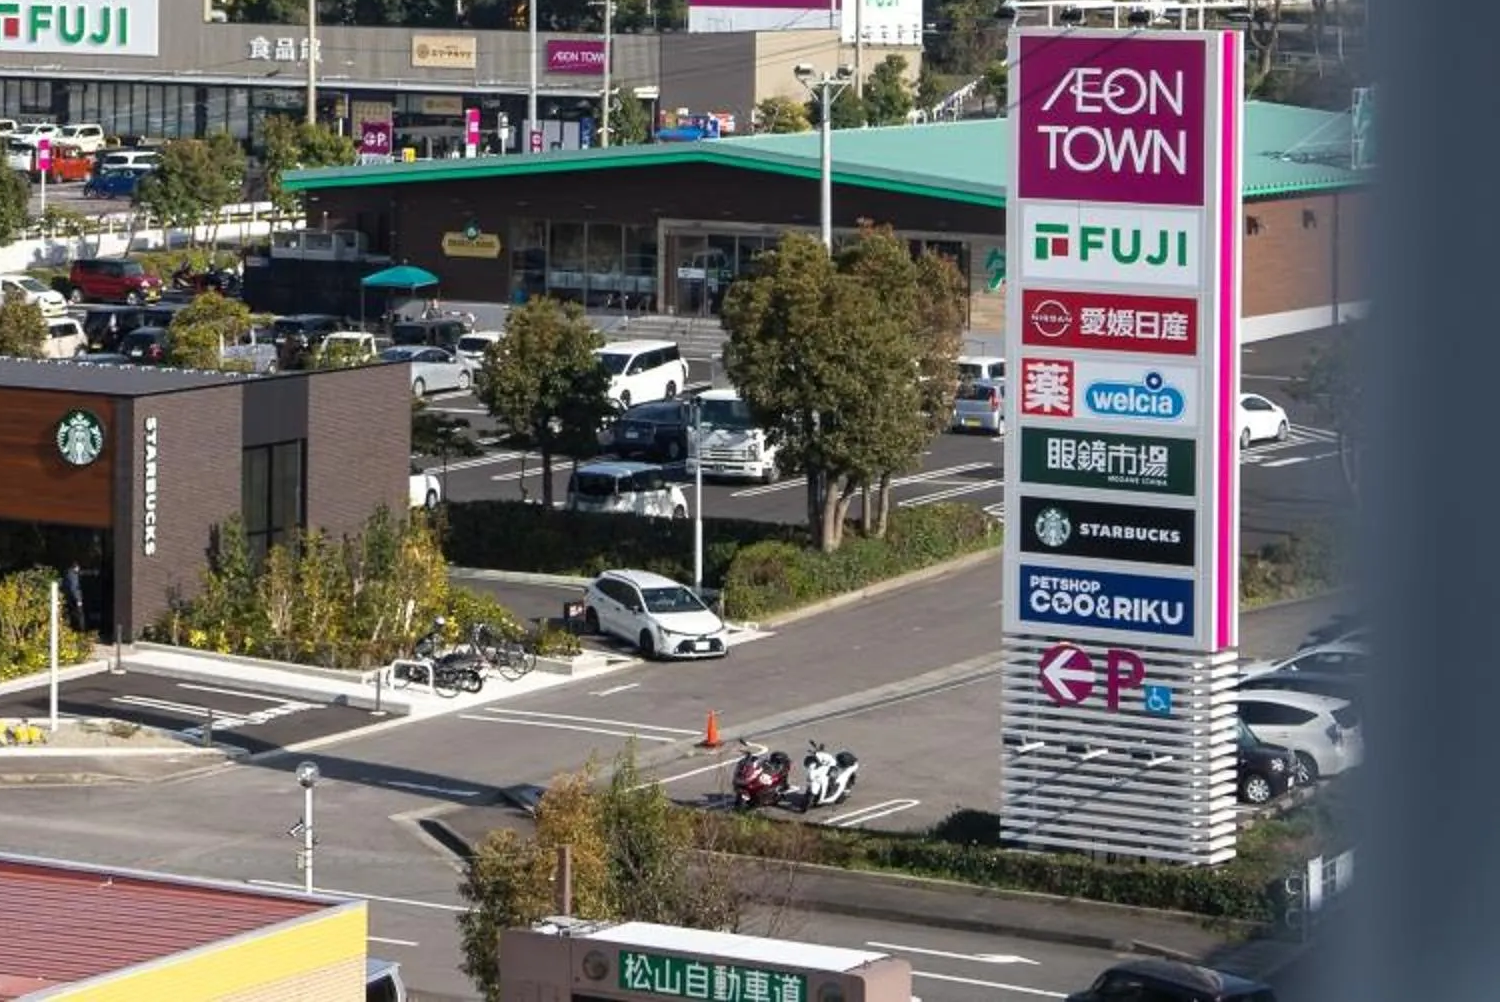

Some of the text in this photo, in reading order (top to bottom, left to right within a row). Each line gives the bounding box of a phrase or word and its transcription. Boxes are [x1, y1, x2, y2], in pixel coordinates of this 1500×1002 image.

[29, 5, 128, 45] FUJI
[580, 51, 605, 62] TOW
[1037, 125, 1187, 176] TOWN
[1079, 225, 1188, 267] FUJI
[1080, 306, 1190, 342] 愛媛日産
[1024, 361, 1072, 413] 薬
[1092, 386, 1174, 415] welcia
[1047, 437, 1169, 478] 眼鏡市場
[145, 416, 158, 556] STARBUCKS
[1079, 522, 1181, 544] STARBUCKS
[1029, 575, 1101, 594] PETSHOP
[1107, 649, 1146, 714] P
